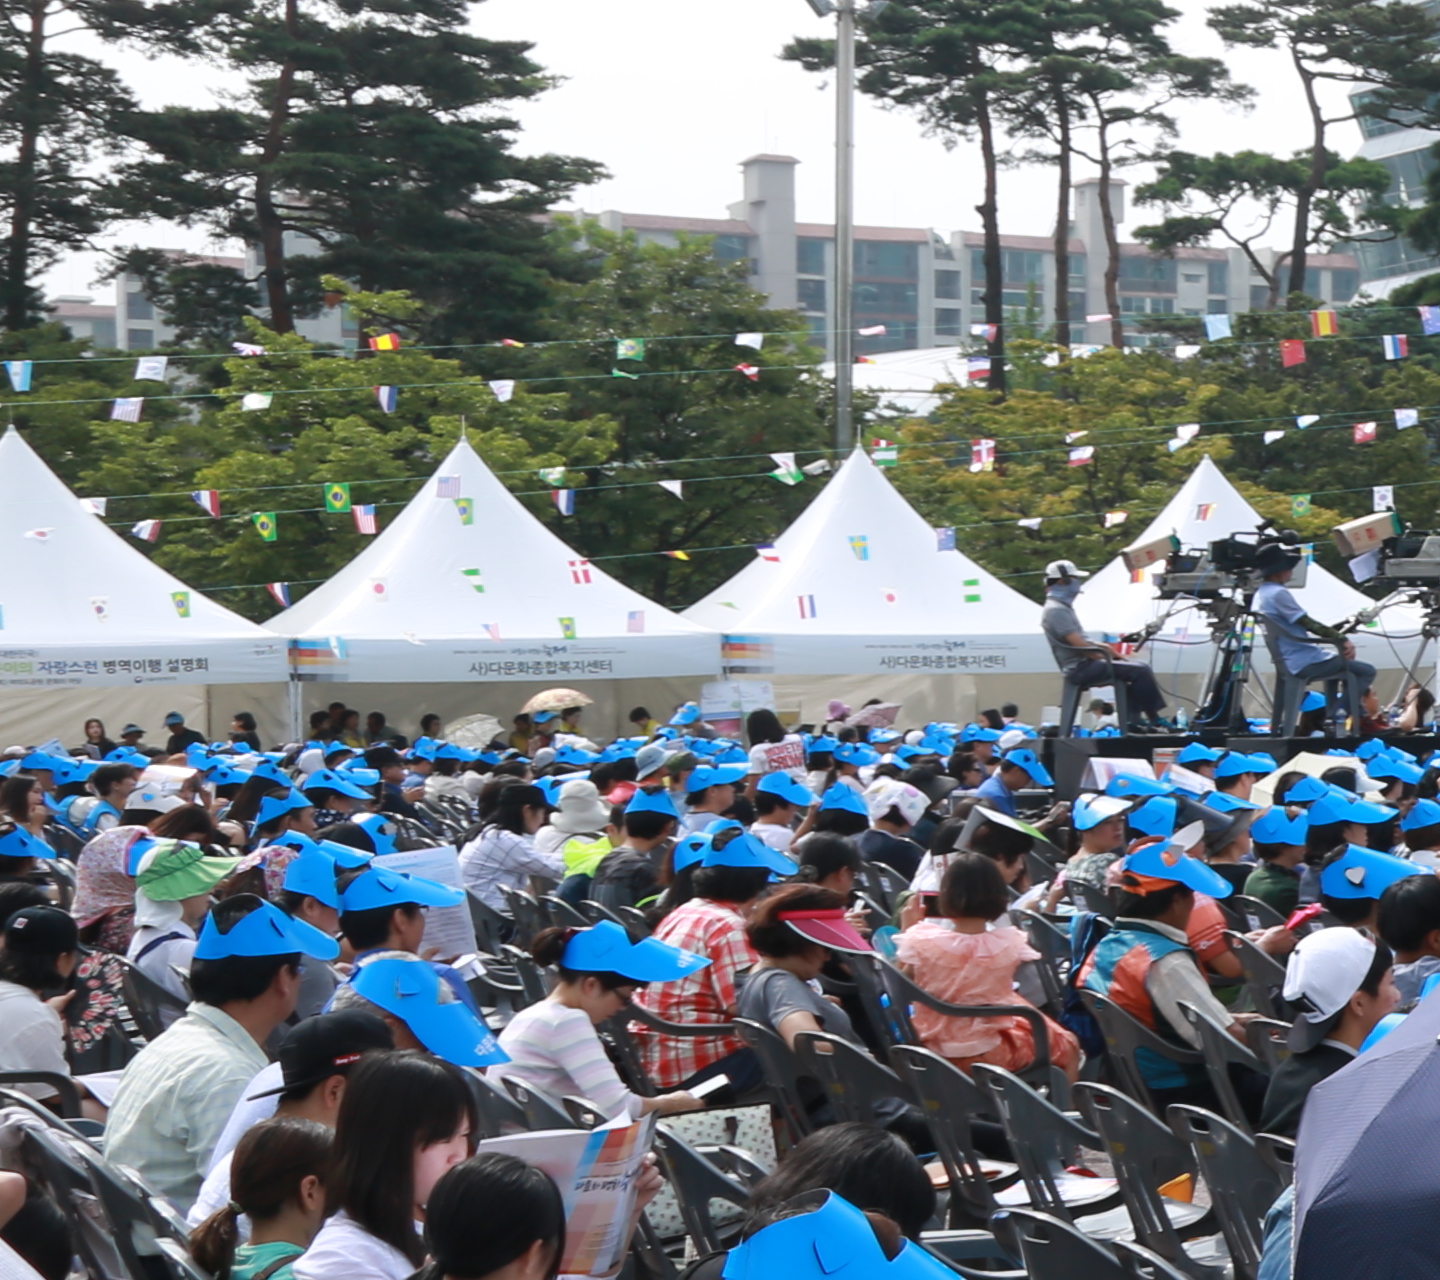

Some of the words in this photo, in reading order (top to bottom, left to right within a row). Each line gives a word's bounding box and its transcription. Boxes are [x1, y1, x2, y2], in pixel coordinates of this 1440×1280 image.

[37, 661, 97, 674] 자랑스런
[103, 658, 162, 674] 병역이행
[167, 657, 209, 672] 설명회
[469, 660, 613, 675] 사)다문화종합복지센터
[880, 655, 1006, 668] 사)다문화종합복지센터
